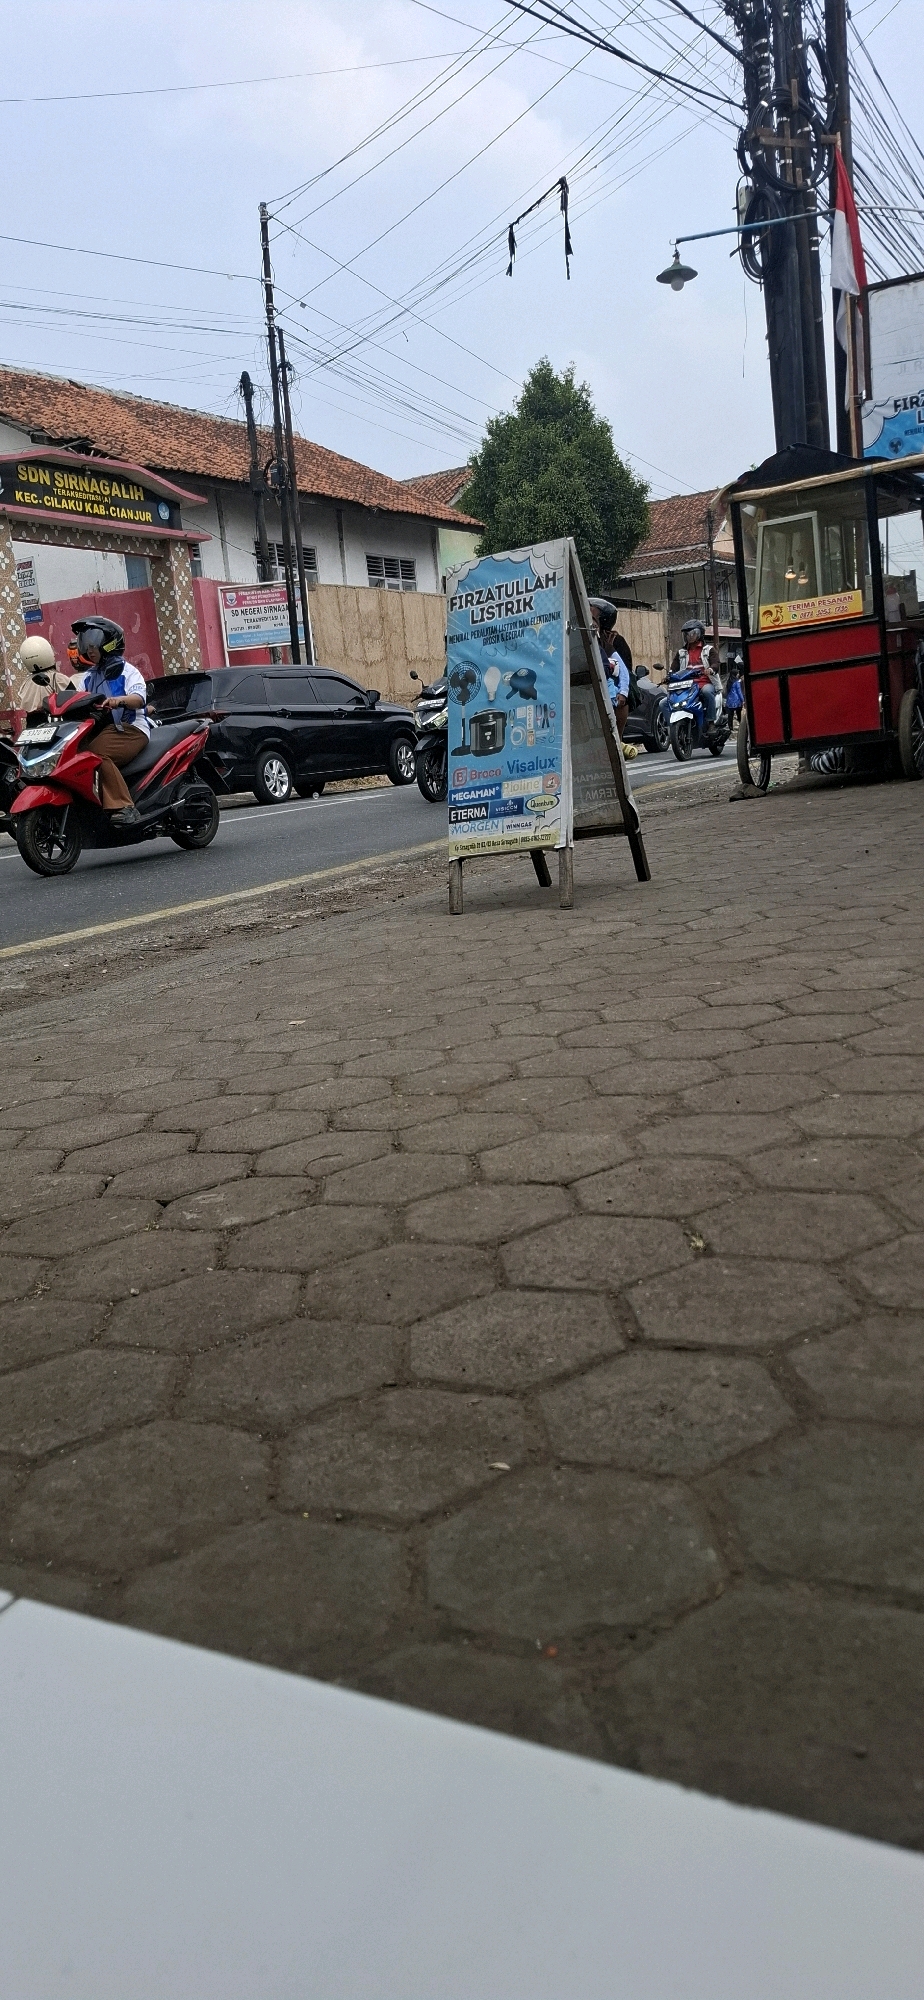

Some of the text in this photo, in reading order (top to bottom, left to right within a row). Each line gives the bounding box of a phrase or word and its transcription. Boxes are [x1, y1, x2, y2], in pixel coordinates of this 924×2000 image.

[17, 464, 144, 501] SDN SIRNAGALIH
[15, 490, 152, 522] KEC. CILAKU KAB. CIANJUR
[53, 488, 101, 502] TERAKREDITASI
[449, 571, 557, 612] FIRZATULLAH
[231, 609, 239, 617] SD
[241, 606, 262, 617] NEGERI
[470, 596, 534, 625] LISTRIK
[787, 595, 853, 611] TERIMA PESANAN
[498, 623, 518, 633] LISTRIK
[518, 619, 529, 629] DAN
[530, 611, 561, 626] ELEKTRONIK
[470, 768, 502, 780] Broco
[507, 756, 556, 774] Visalux
[451, 807, 487, 821] ETERNA
[451, 820, 499, 836] MORGEN
